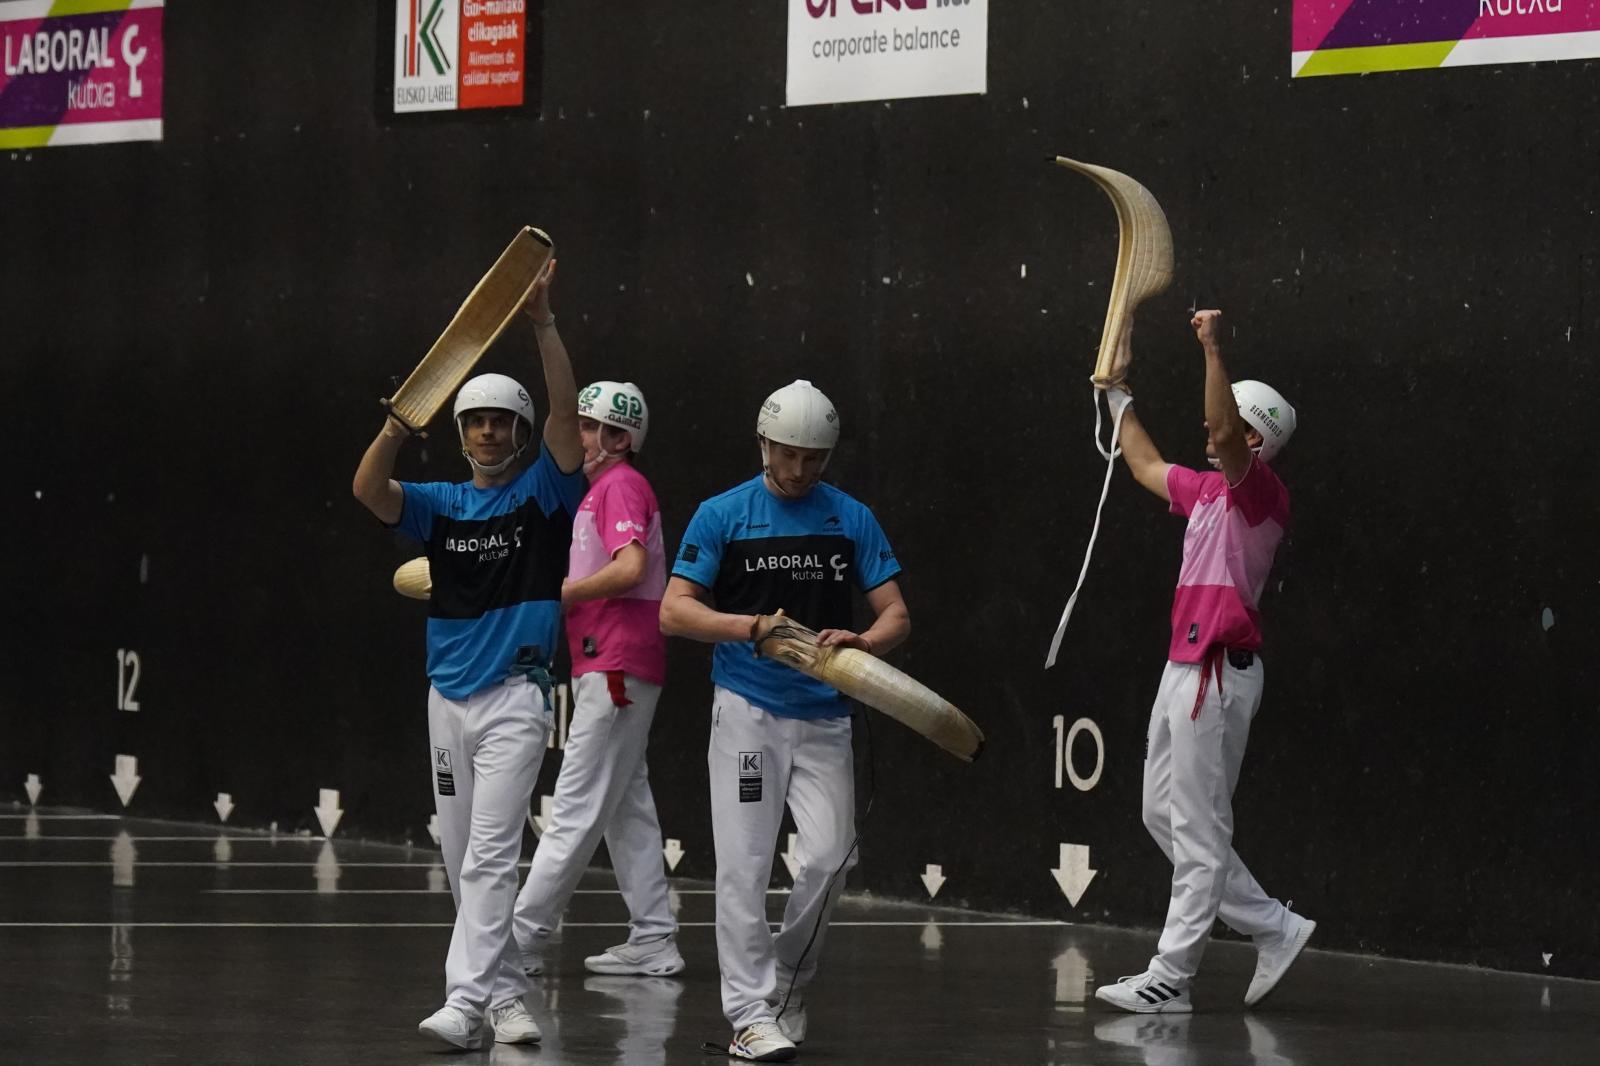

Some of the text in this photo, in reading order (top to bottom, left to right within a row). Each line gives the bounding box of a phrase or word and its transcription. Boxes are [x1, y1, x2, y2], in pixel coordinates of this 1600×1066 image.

[5, 27, 115, 76] LABORAL
[812, 26, 960, 62] corporate balance
[67, 80, 116, 110] kutxa
[397, 84, 454, 105] EUSKO LABEL
[446, 533, 509, 552] LABORAL
[479, 548, 509, 562] kutxa
[745, 554, 823, 572] LABORAL
[791, 570, 824, 581] kutxa
[117, 648, 140, 712] 12
[1053, 714, 1104, 791] 10
